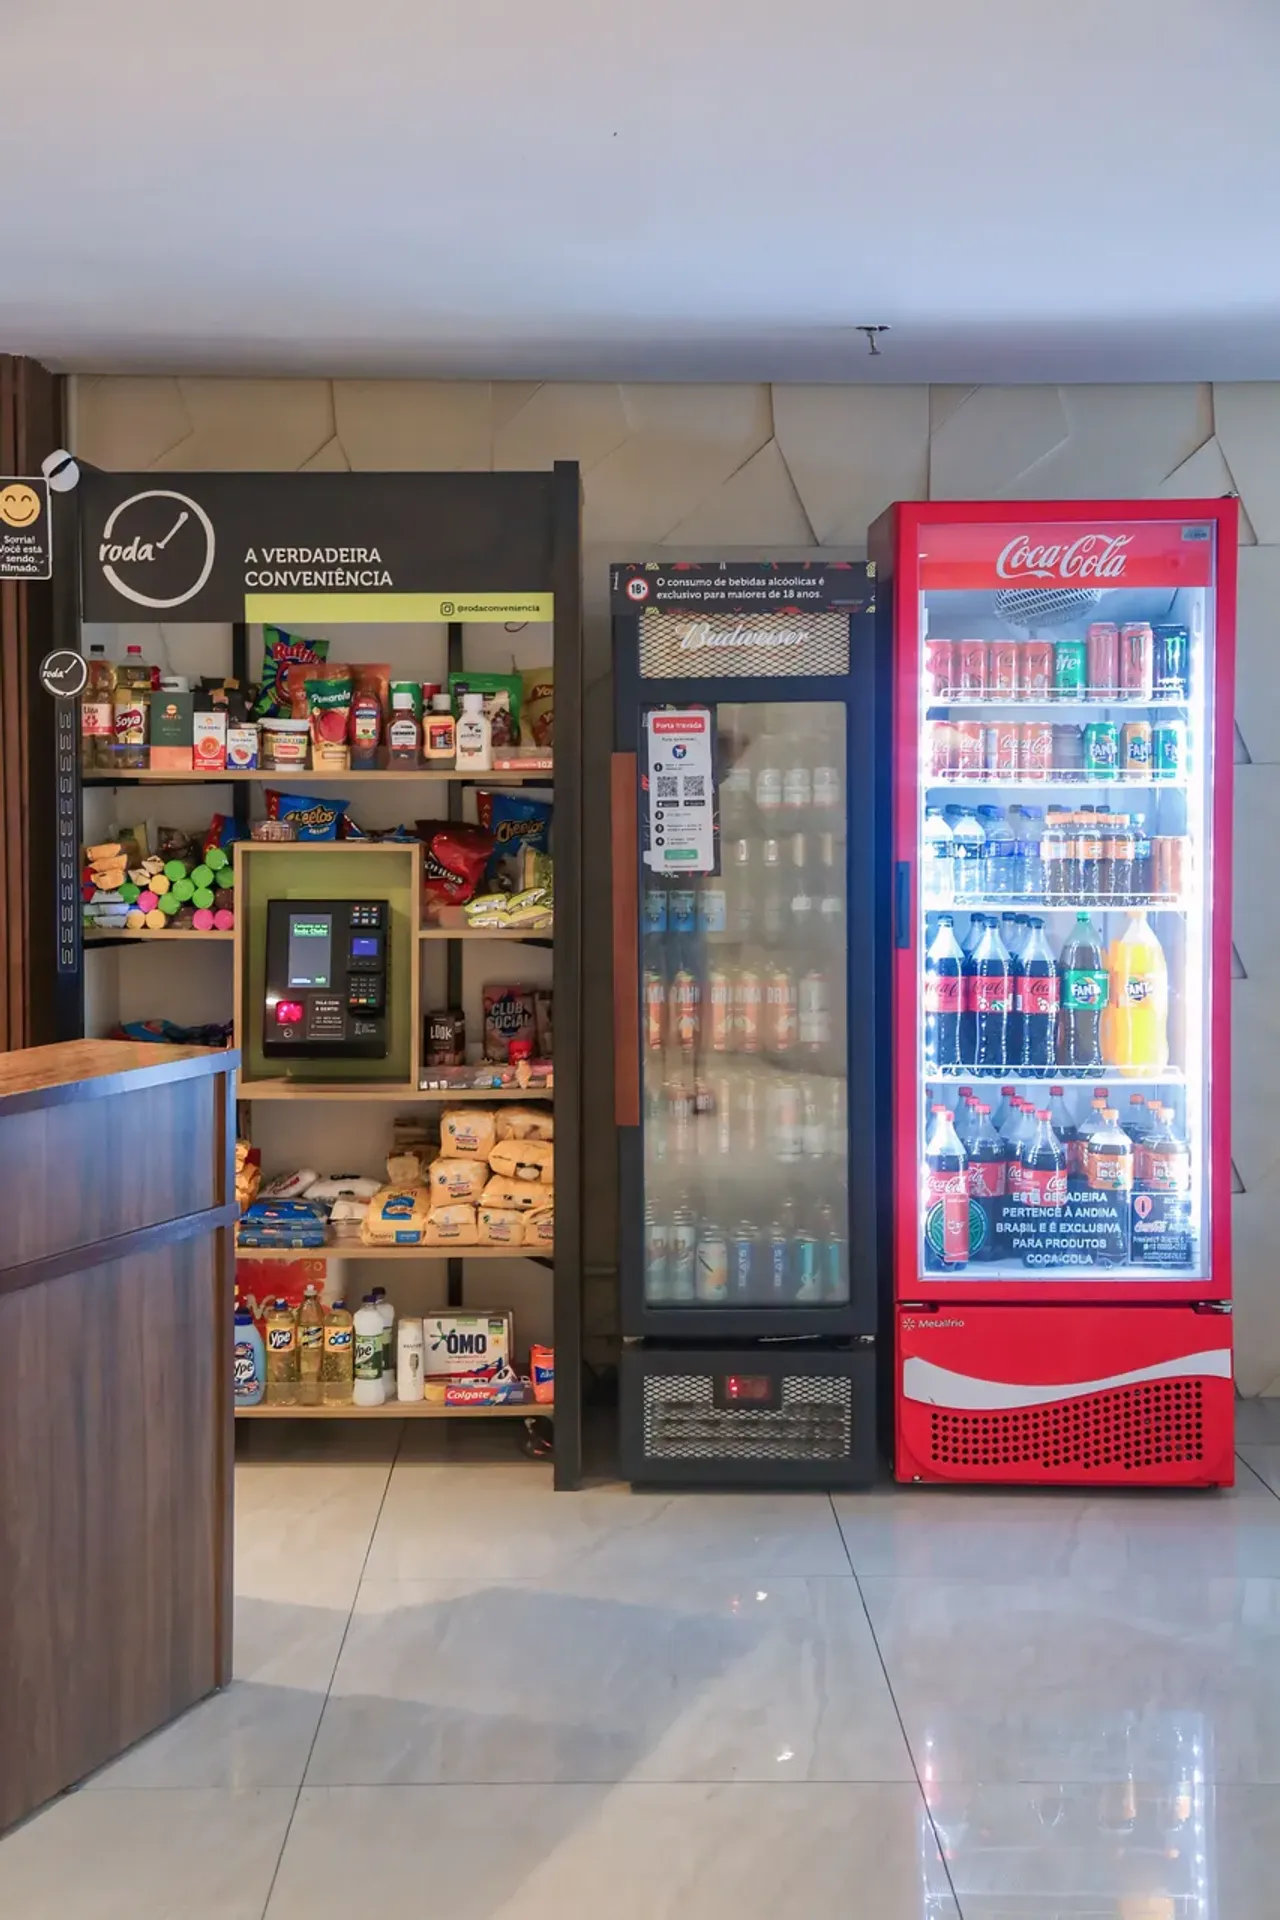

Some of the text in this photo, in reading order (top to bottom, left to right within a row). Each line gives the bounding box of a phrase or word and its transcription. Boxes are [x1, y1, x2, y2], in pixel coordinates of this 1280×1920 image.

[99, 536, 155, 562] roda
[244, 548, 382, 563] A VERDADEIRA
[996, 532, 1135, 579] Coca-Cola
[244, 568, 393, 587] CONVENIÊNCIA
[656, 577, 665, 587] O
[667, 578, 712, 587] consumo
[714, 577, 726, 587] de
[729, 577, 766, 587] bebidas
[818, 576, 825, 586] é
[656, 590, 823, 601] exclusivo para maiores de 18 anos.
[457, 604, 540, 614] @rodaconveniencia
[675, 622, 809, 650] Budweiser
[536, 686, 554, 697] Yo
[116, 714, 141, 727] Soya
[496, 821, 545, 843] Cheetos
[424, 861, 463, 884] oritos
[491, 1002, 523, 1015] CLUB
[430, 1025, 452, 1039] LOOK
[1002, 1207, 1062, 1217] PERTENCE
[1075, 1207, 1118, 1217] ANDINA
[996, 1222, 1036, 1233] BRASIL
[1039, 1222, 1047, 1232] E
[1060, 1222, 1122, 1233] EXCLUSIVA
[1012, 1238, 1107, 1248] PARA PRODUTOS
[1026, 1253, 1093, 1264] COCA-COLA
[918, 1319, 965, 1328] Metalfrio
[446, 1333, 487, 1354] OMO
[446, 1389, 491, 1401] Colgate
